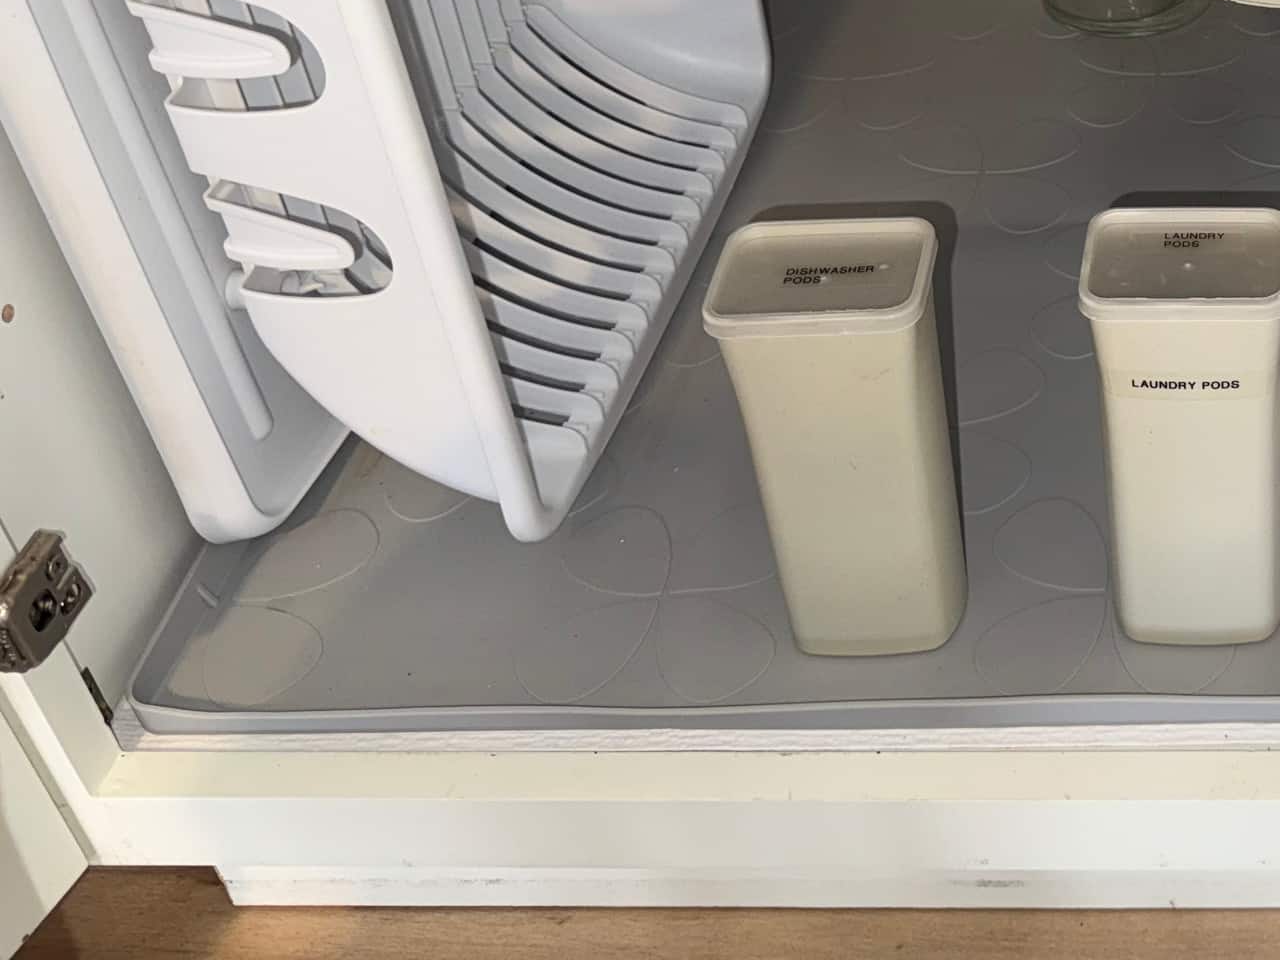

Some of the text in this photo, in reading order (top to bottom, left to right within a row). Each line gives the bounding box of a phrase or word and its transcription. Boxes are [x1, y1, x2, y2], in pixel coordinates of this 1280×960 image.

[1164, 232, 1225, 241] LAUNDRY
[1163, 241, 1201, 249] PODS
[785, 265, 875, 277] DISHWASHER
[782, 275, 822, 286] PODS
[1131, 379, 1240, 390] LAUNDRY PODS
